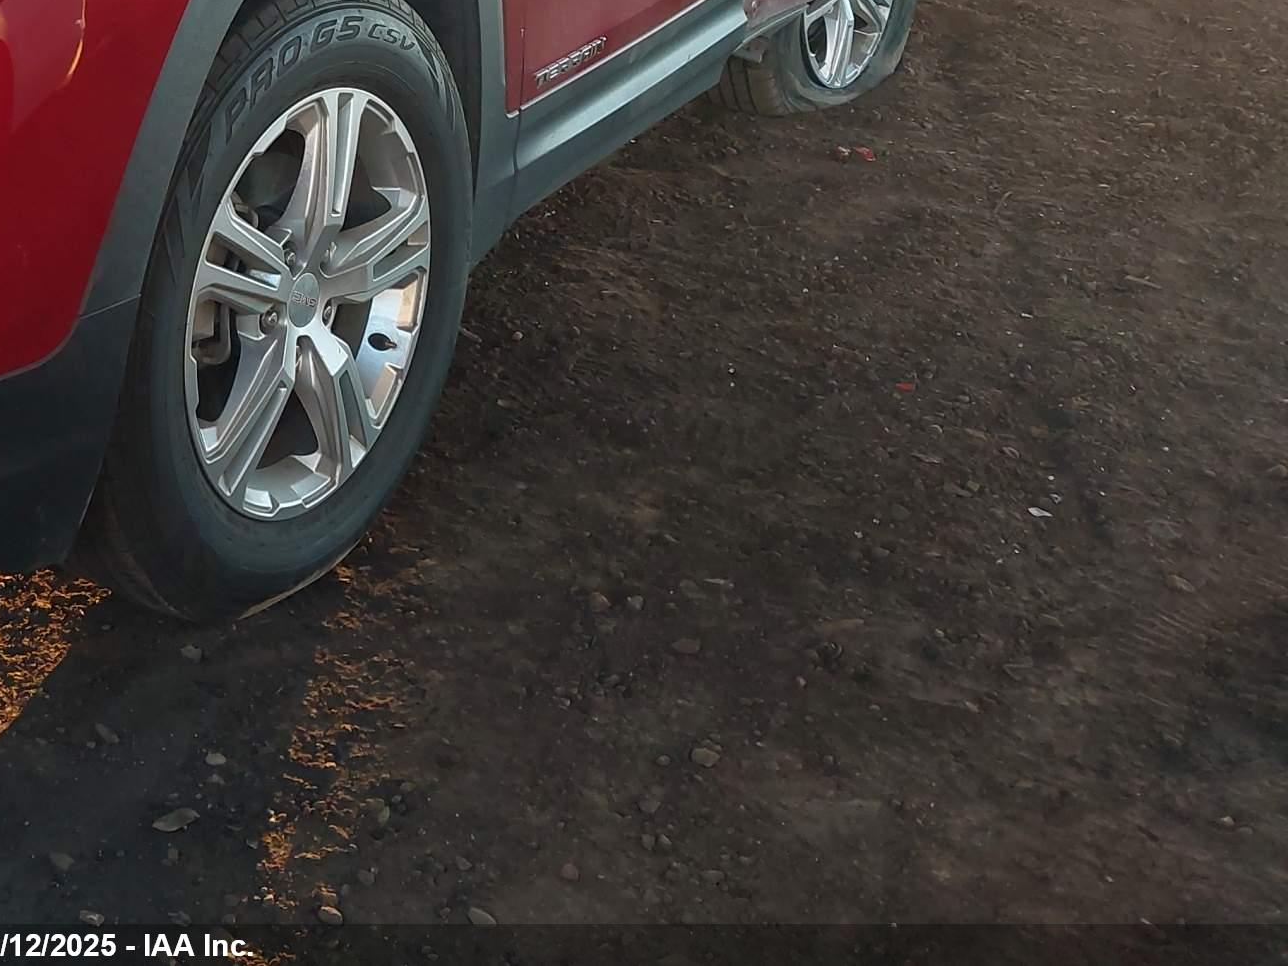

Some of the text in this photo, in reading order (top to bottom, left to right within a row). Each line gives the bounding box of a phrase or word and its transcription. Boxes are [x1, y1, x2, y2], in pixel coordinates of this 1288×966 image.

[224, 15, 416, 145] PRO G5 CSV
